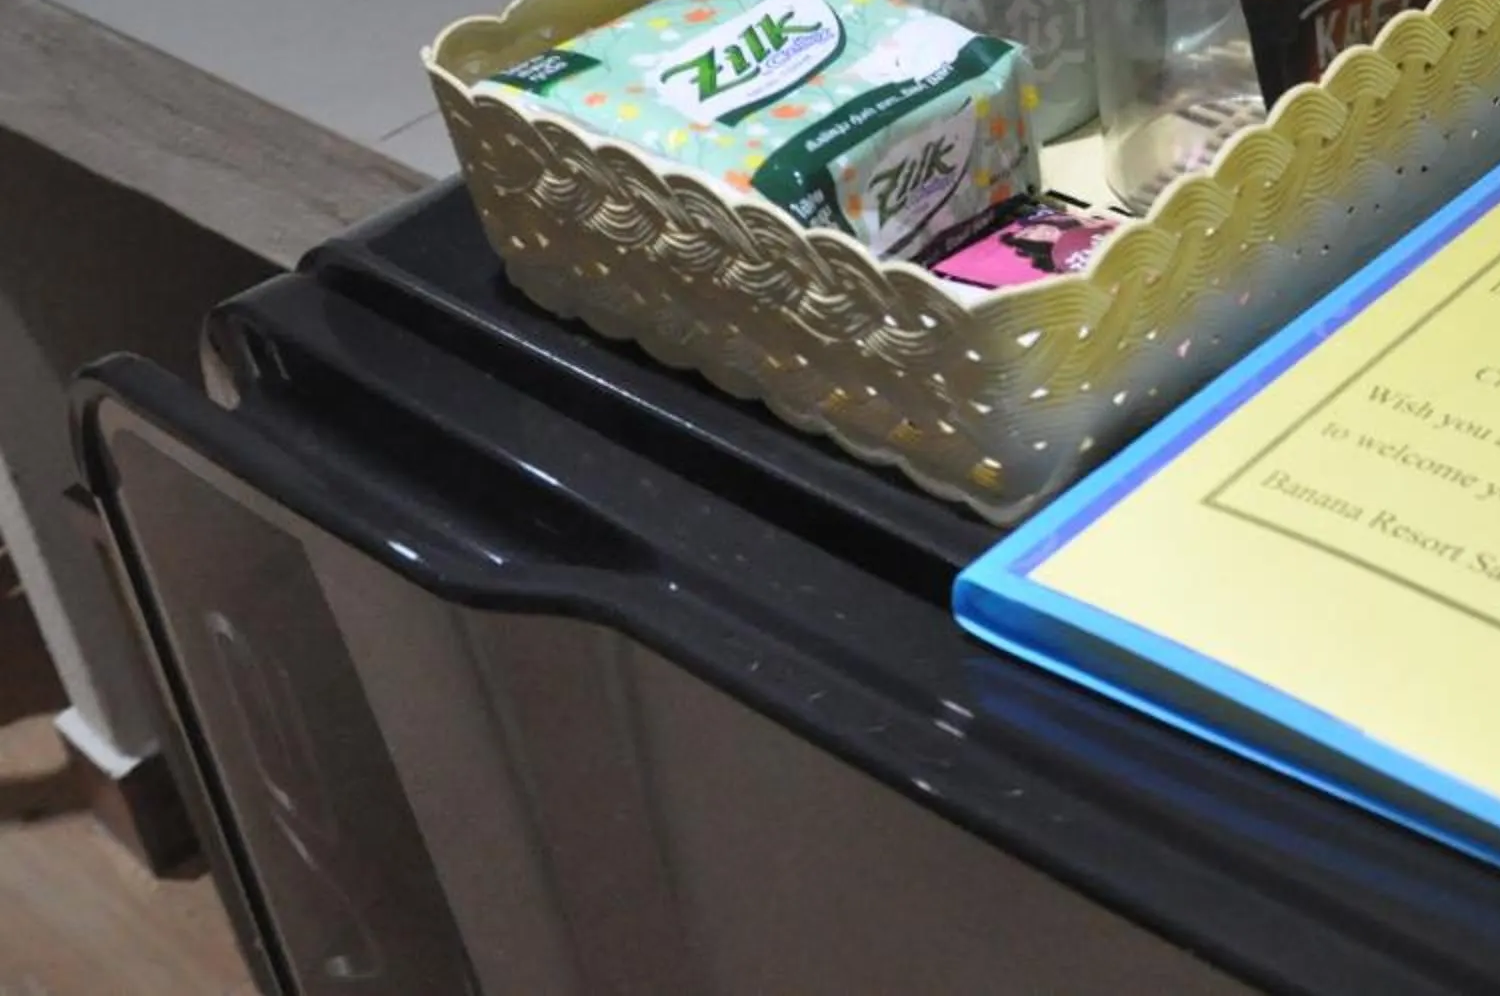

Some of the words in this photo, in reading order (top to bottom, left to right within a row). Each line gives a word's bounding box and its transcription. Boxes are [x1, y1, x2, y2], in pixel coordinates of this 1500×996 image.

[660, 11, 823, 102] Zilk
[869, 135, 957, 227] Zilk
[1322, 423, 1349, 437] to
[1358, 435, 1478, 488] welcome
[1369, 385, 1434, 420] Wish
[1434, 414, 1492, 440] you
[1261, 471, 1363, 520] Banana
[1369, 510, 1464, 561] Resort
